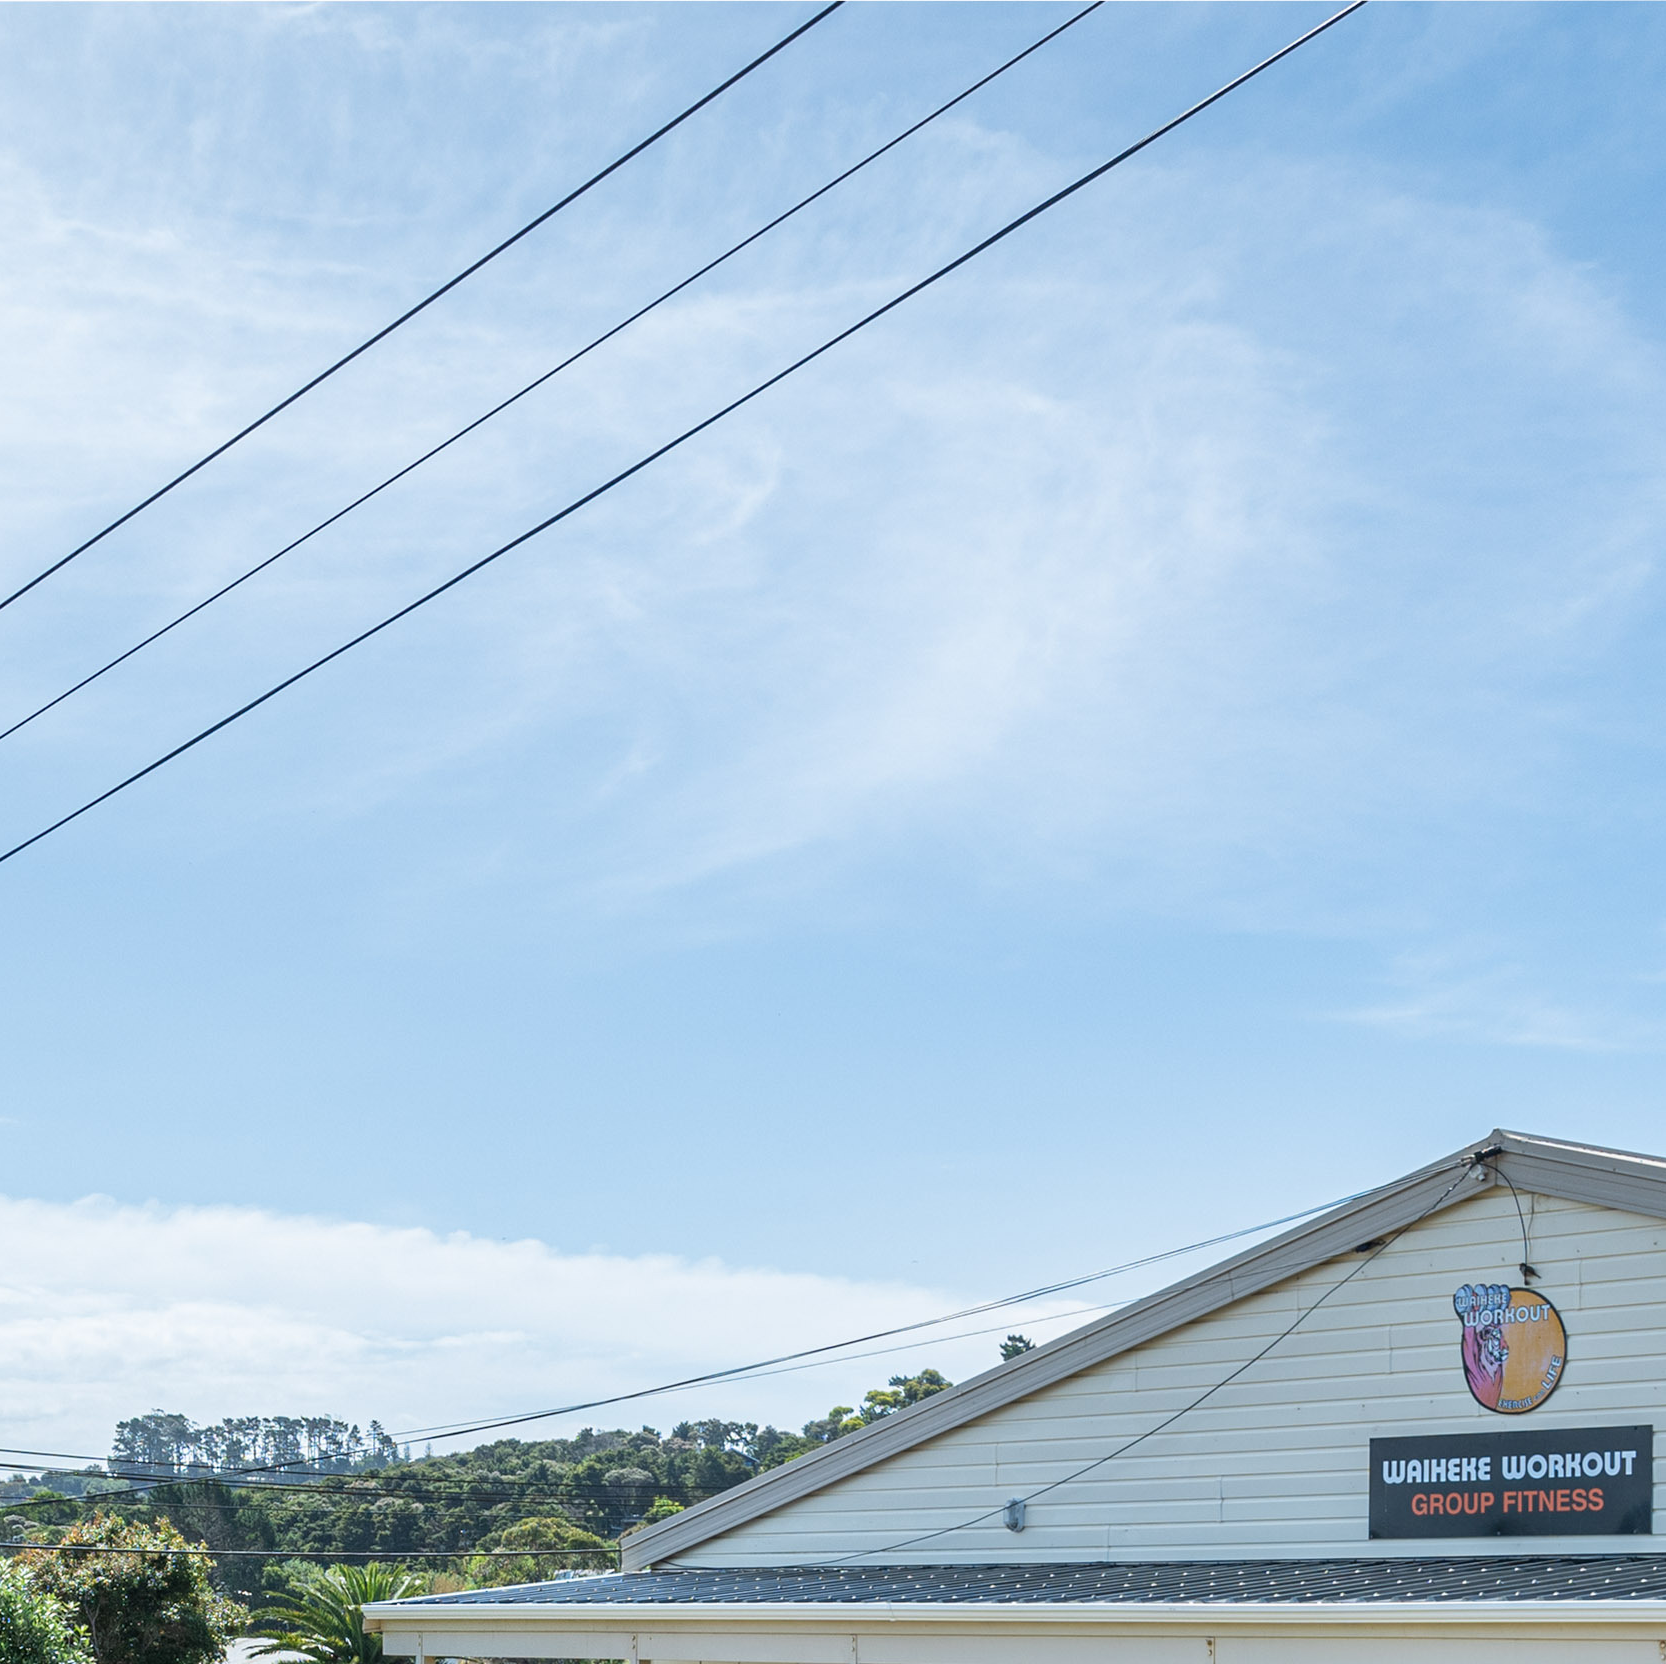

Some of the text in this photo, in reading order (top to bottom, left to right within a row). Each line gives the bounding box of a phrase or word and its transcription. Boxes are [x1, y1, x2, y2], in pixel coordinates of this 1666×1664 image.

[1458, 1293, 1507, 1307] WAIHEKE
[1464, 1304, 1551, 1326] WORKOUT
[1541, 1355, 1562, 1390] LIFE
[1382, 1450, 1636, 1484] WAIHEKE WORKOUT
[1411, 1488, 1604, 1515] GROUP FITNESS
